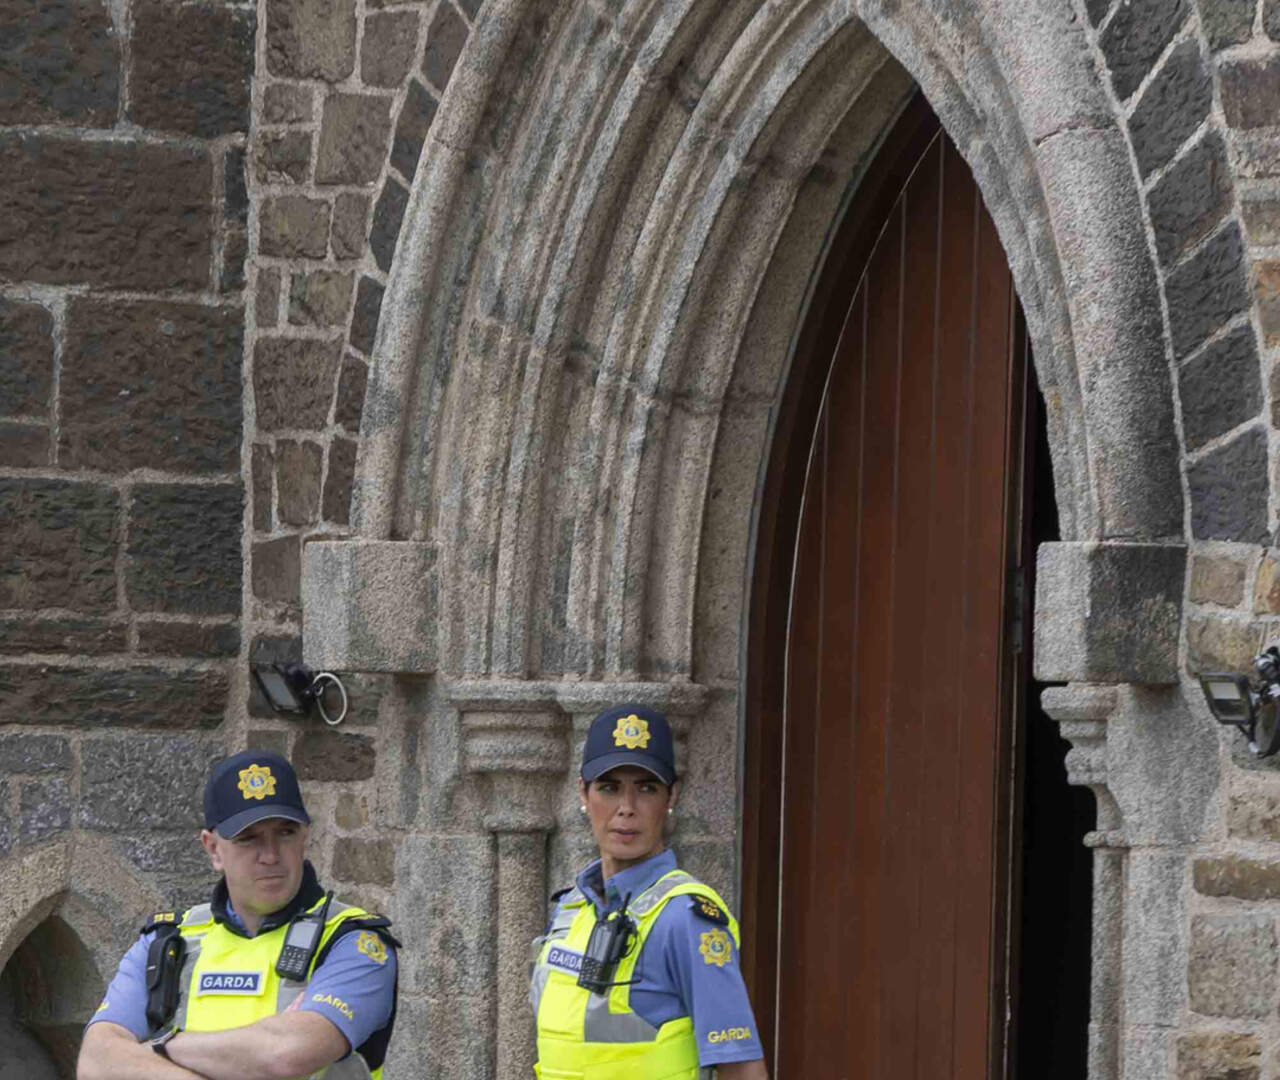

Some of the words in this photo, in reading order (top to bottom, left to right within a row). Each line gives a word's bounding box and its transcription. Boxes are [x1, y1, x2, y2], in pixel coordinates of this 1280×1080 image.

[202, 976, 255, 989] GARDA
[311, 993, 354, 1020] GARDA
[707, 1027, 751, 1043] GARDA
